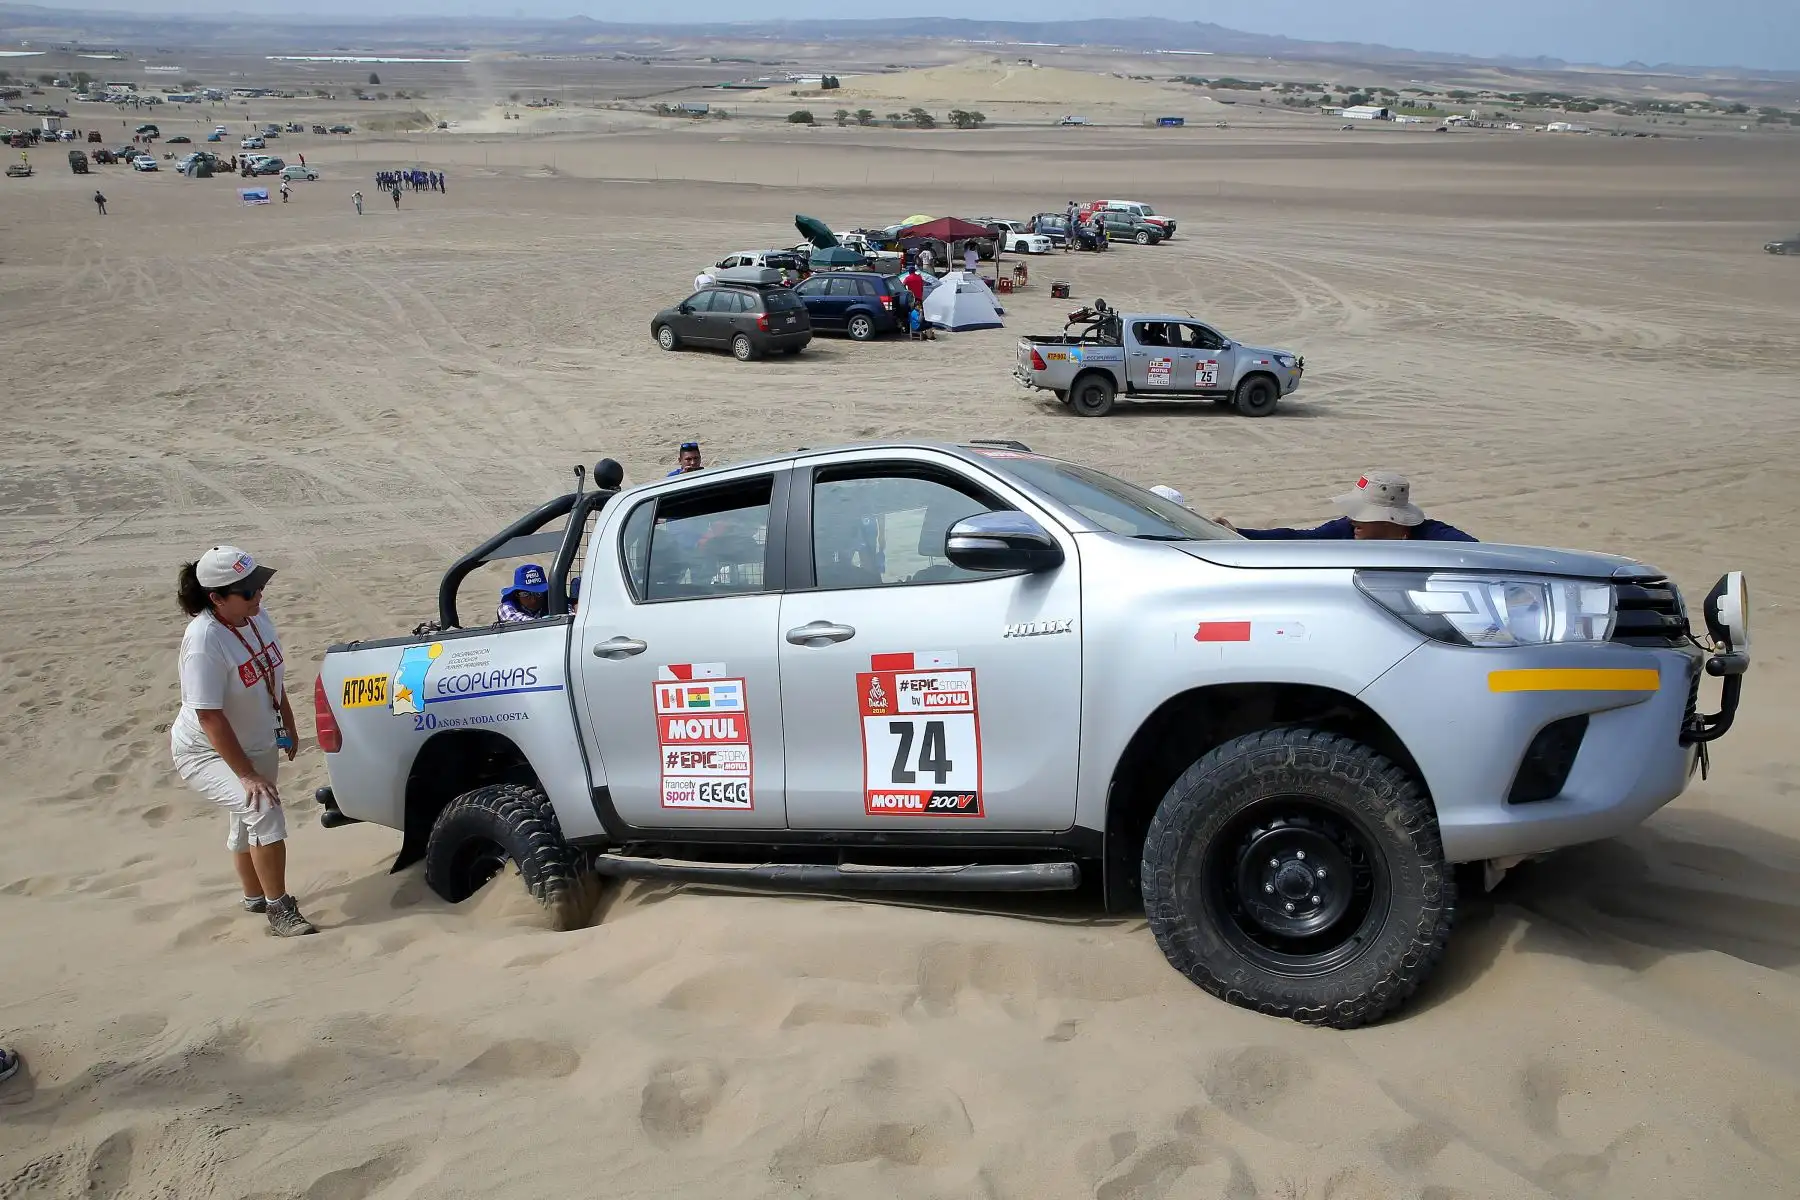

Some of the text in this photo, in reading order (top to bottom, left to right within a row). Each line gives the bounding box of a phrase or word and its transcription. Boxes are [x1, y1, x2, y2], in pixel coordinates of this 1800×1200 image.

[1003, 618, 1074, 638] HILUX
[437, 666, 538, 694] ECOPLAYAS
[343, 676, 387, 706] ATP-937
[911, 693, 968, 706] by MOTUL
[414, 713, 437, 731] 20
[462, 718, 469, 726] A
[469, 715, 496, 725] TODA
[496, 712, 530, 723] COSTA
[668, 718, 739, 740] MOTUL
[724, 762, 747, 770] MOTUL
[665, 789, 696, 803] sport
[871, 794, 974, 809] MOTUL 300V
